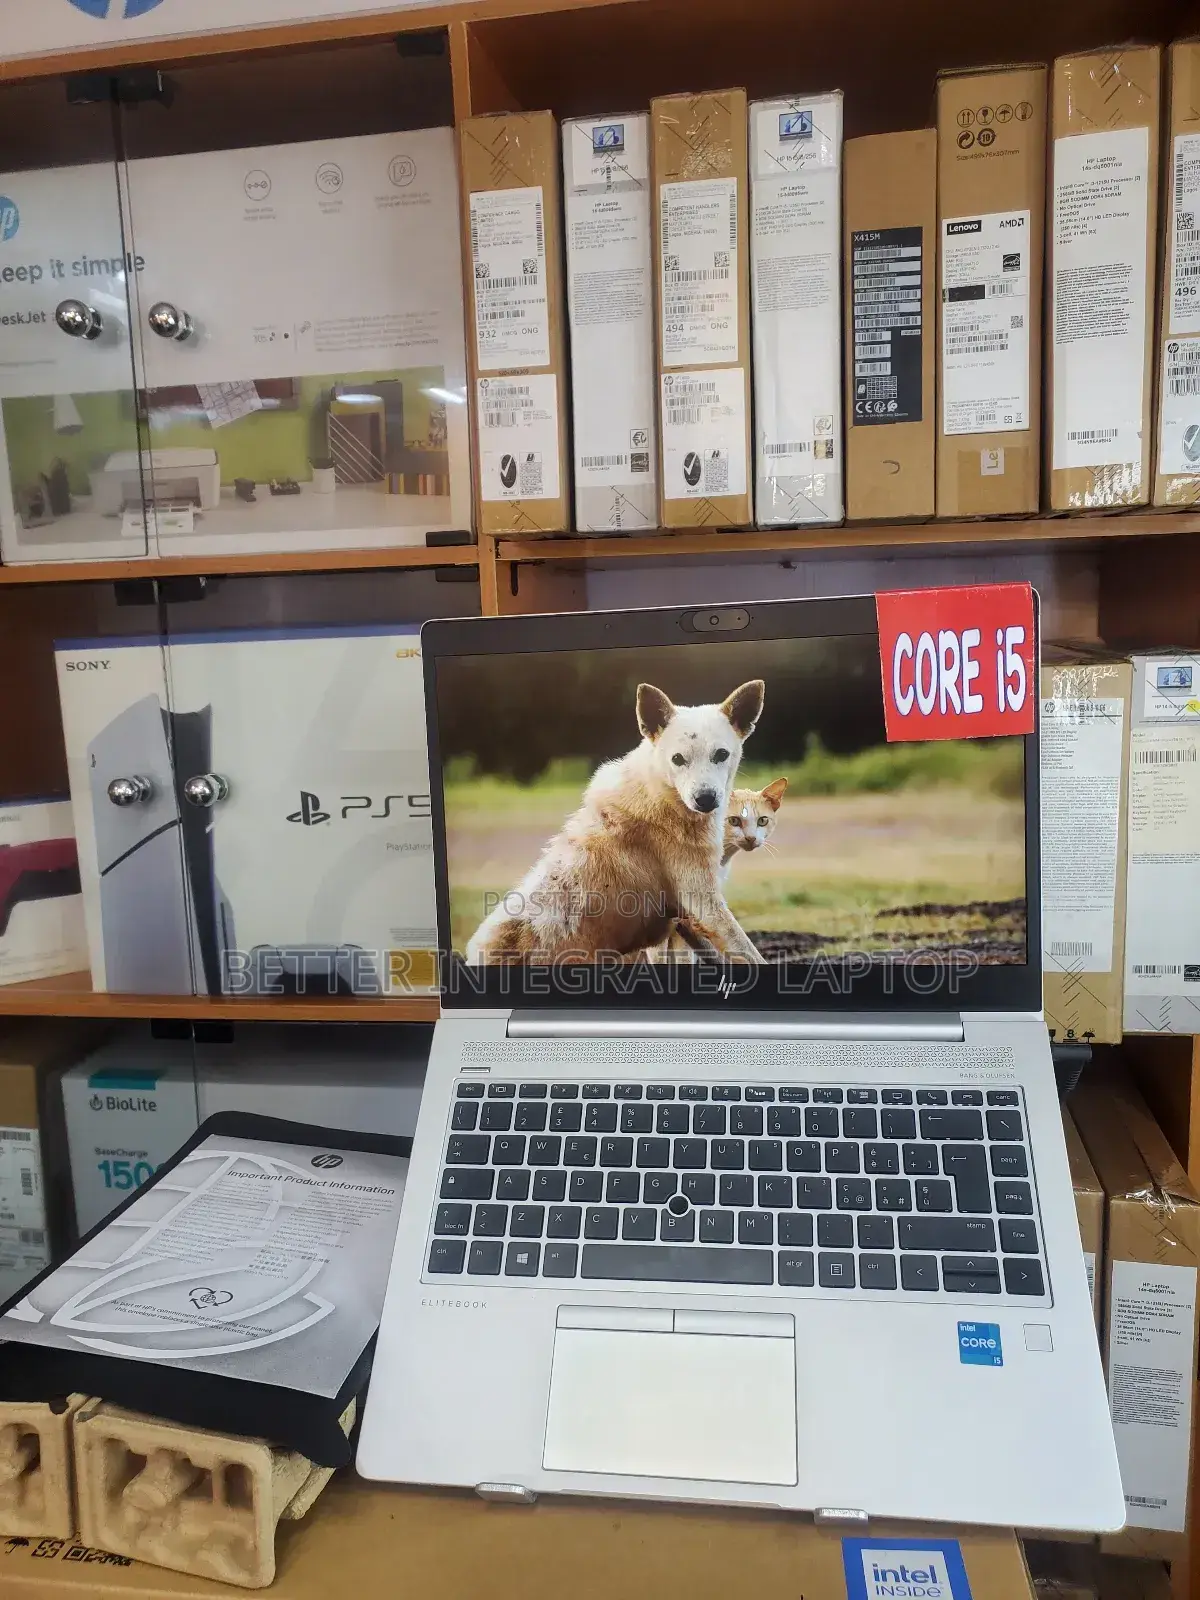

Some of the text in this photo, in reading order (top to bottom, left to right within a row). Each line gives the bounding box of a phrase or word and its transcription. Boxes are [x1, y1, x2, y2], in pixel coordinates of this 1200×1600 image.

[949, 223, 979, 232] Lenovo
[854, 233, 880, 242] X415M
[0, 252, 146, 284] eep it simple
[1175, 286, 1197, 296] 496
[0, 310, 46, 326] eskJet
[479, 327, 538, 339] 932 ONG
[666, 322, 729, 333] 494 ONG
[65, 661, 110, 672] SONY
[893, 625, 1027, 716] CORE i5
[340, 794, 431, 819] PS5
[718, 974, 737, 1000] hp
[106, 1096, 157, 1112] BioLite
[95, 1147, 148, 1158] BaseCharge
[500, 1141, 509, 1149] Q
[536, 1142, 547, 1150] W
[571, 1142, 578, 1150] E
[607, 1143, 615, 1151] R
[682, 1144, 689, 1152] Y
[718, 1145, 726, 1154] U
[795, 1148, 803, 1156] O
[311, 1154, 343, 1168] hp
[98, 1160, 166, 1190] 150
[228, 1170, 395, 1195] Important Product Information
[577, 1178, 585, 1186] D
[613, 1178, 620, 1187] F
[652, 1179, 660, 1187] G
[689, 1180, 696, 1188] H
[765, 1183, 773, 1191] K
[592, 1214, 600, 1223] C
[669, 1218, 676, 1227] B
[707, 1218, 715, 1226] N
[746, 1219, 755, 1228] M
[966, 1222, 986, 1230] stamp
[421, 1299, 487, 1309] ELITEBOOK
[128, 1309, 156, 1317] envelope
[157, 1308, 197, 1319] commitment
[960, 1323, 976, 1332] intel
[872, 1563, 938, 1584] intel
